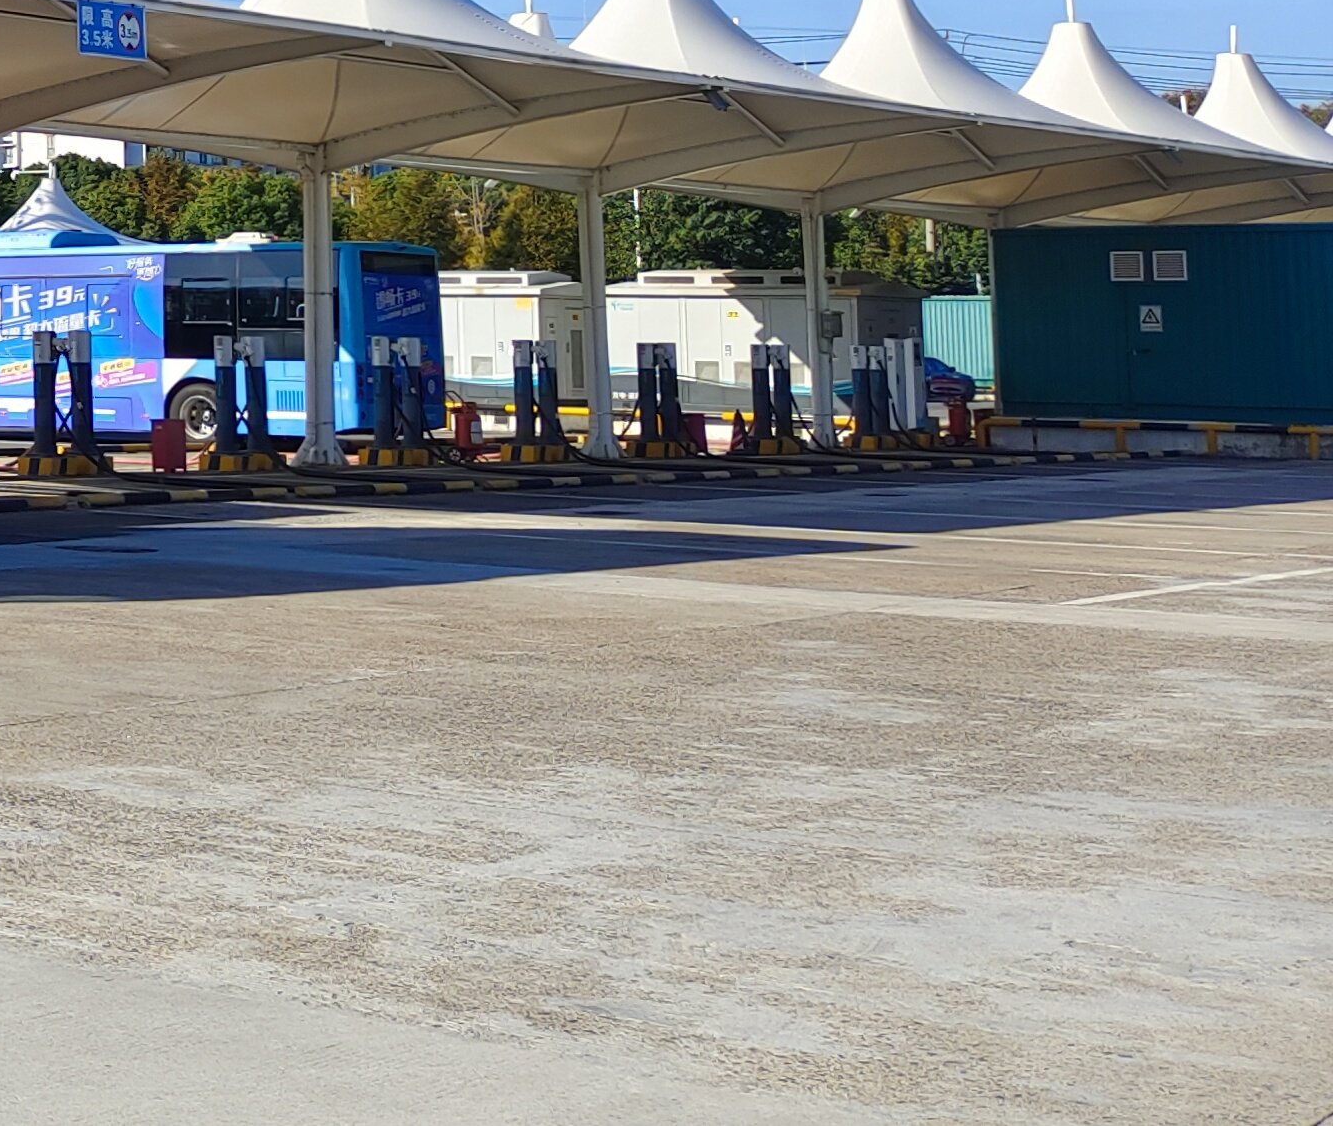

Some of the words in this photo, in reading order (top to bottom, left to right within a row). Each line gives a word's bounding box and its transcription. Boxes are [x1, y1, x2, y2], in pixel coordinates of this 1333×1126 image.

[81, 5, 114, 29] 限高
[81, 29, 114, 50] 3.5米
[38, 285, 86, 311] 39元
